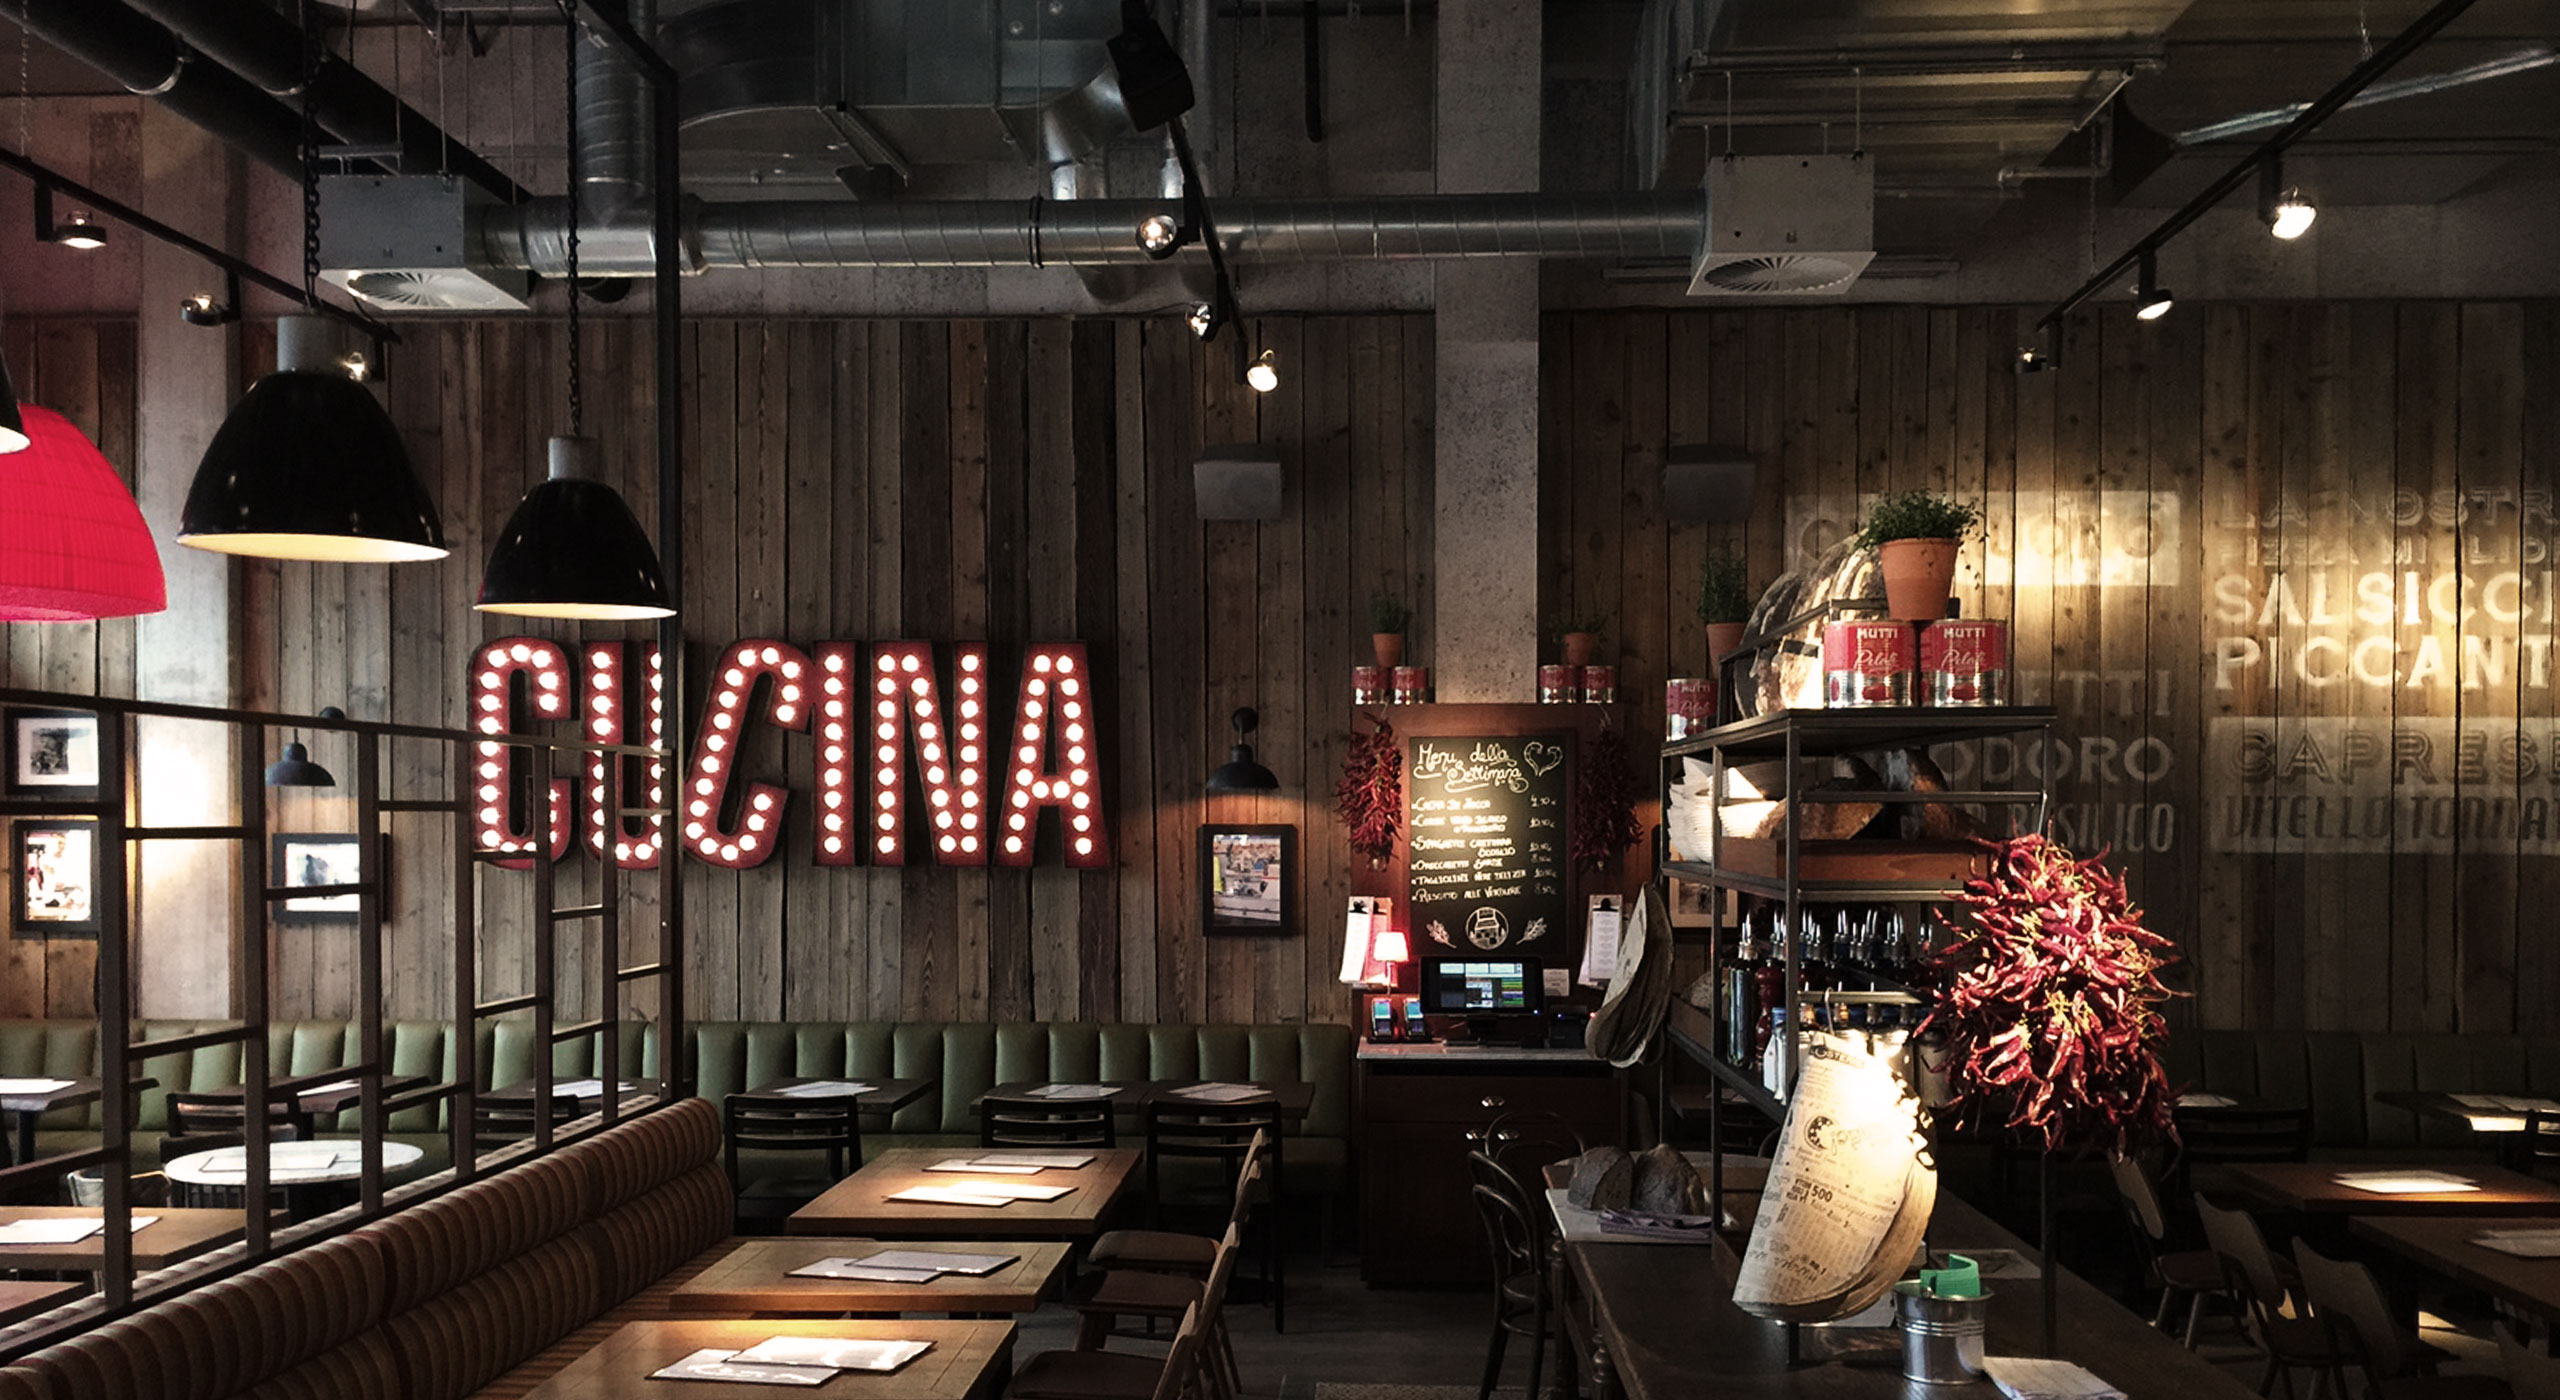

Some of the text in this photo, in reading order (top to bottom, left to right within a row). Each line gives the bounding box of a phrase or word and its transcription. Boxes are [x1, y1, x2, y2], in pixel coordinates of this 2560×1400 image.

[2212, 570, 2557, 626] SALSICCI
[1856, 627, 1898, 639] MUTTI
[1943, 627, 1986, 639] MUTTI
[2212, 635, 2560, 690] PICCANT
[470, 637, 1114, 870] CUCINA
[1414, 742, 1517, 777] Menu della
[1929, 736, 2174, 784] ODORO
[1811, 1185, 1833, 1202] 500
